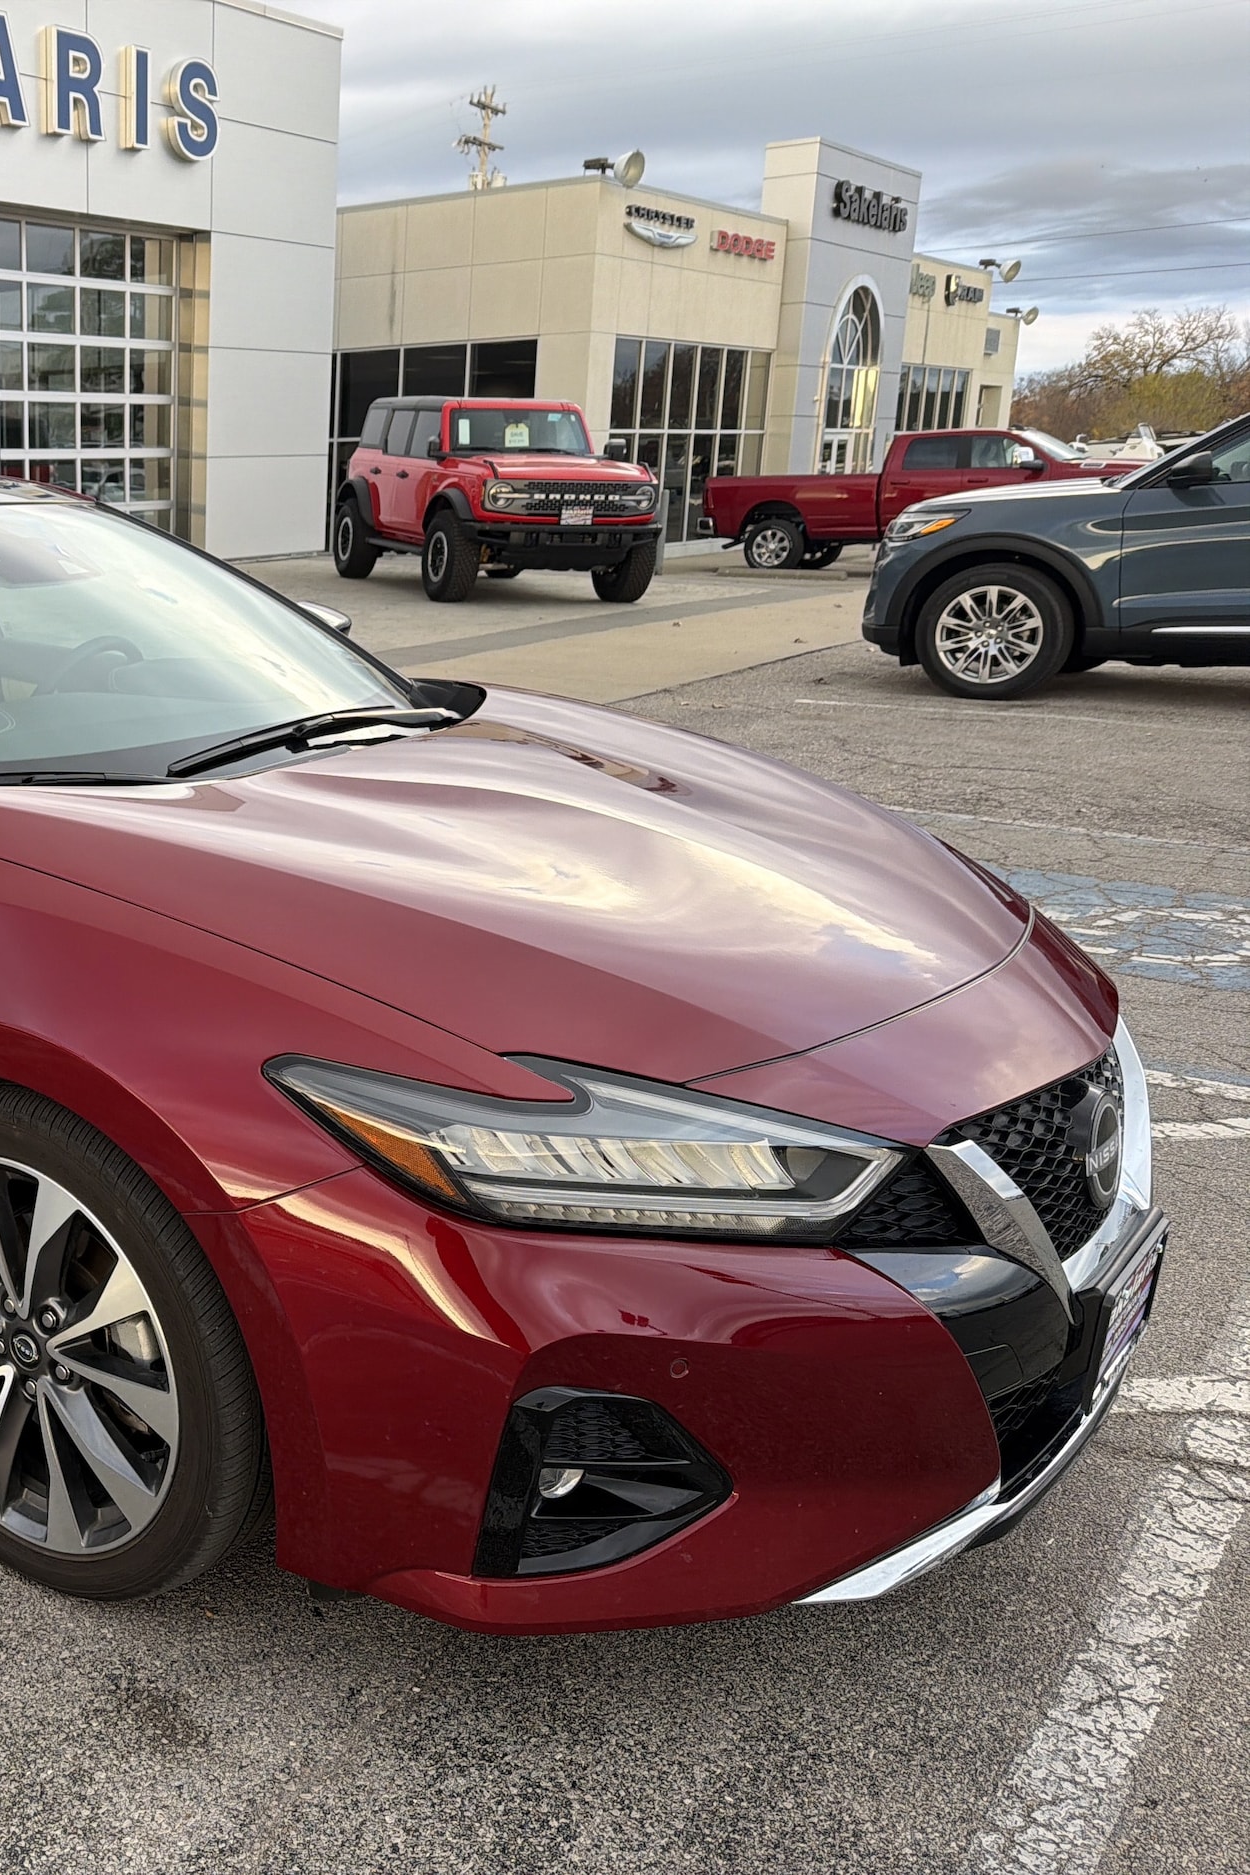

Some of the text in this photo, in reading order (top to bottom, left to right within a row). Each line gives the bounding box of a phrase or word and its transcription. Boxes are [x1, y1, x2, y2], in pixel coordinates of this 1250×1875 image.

[625, 204, 695, 229] CHRYSLER
[833, 180, 908, 232] Sakelaris
[713, 230, 776, 260] DODGE
[910, 264, 936, 304] Jeep
[533, 493, 620, 501] BRONCO
